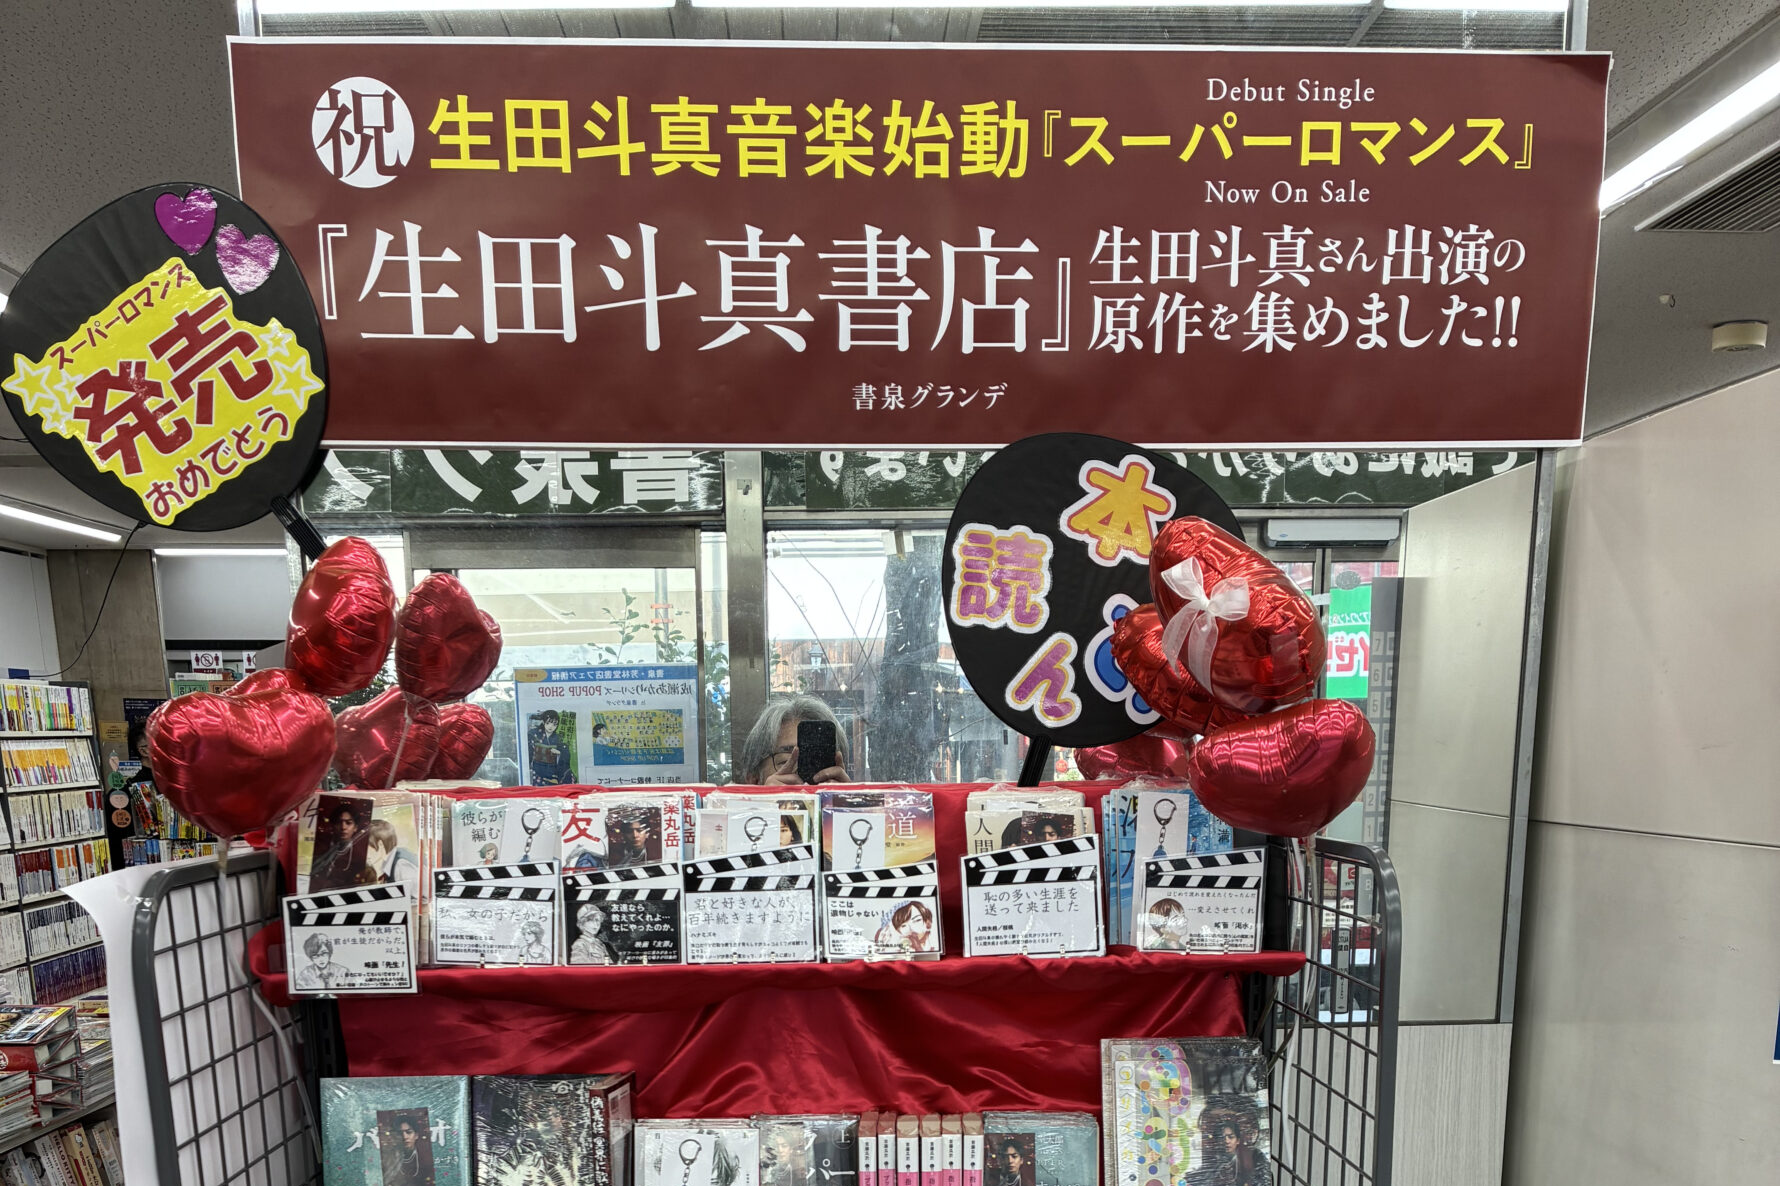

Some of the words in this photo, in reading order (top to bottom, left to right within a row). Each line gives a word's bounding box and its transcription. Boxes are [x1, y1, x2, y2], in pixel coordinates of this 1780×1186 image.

[1206, 77, 1285, 102] Debut
[1298, 77, 1376, 110] Single
[313, 76, 415, 189] 祝
[428, 94, 1533, 179] 生田斗真音楽始動『スーパーロマンス』
[1205, 181, 1260, 203] Now
[1271, 181, 1309, 203] On
[1321, 181, 1370, 203] Sale
[317, 220, 1070, 352] 『生田斗真書店』
[1089, 224, 1526, 288] 生田斗真さん出演の
[50, 264, 191, 370] スーパーロマンス
[1087, 293, 1521, 354] 原作を集めました!!
[73, 295, 274, 475] 発売
[851, 380, 1008, 410] 書泉グランデ
[146, 407, 289, 517] おめでとう
[1067, 462, 1171, 561] 本
[960, 530, 1048, 627] 読
[1012, 639, 1076, 722] ん
[461, 811, 502, 826] 彼らが
[472, 828, 501, 842] 編む
[561, 803, 600, 843] 友
[663, 801, 681, 848] 薬丸岳
[887, 812, 918, 839] 道
[611, 903, 645, 912] 友達なら
[830, 900, 854, 908] ここは
[983, 887, 1079, 903] 恥の多い生涯を
[984, 900, 1080, 916] 送って来ました
[612, 923, 674, 932] なにやったのか。
[688, 911, 811, 925] 百年続きますように
